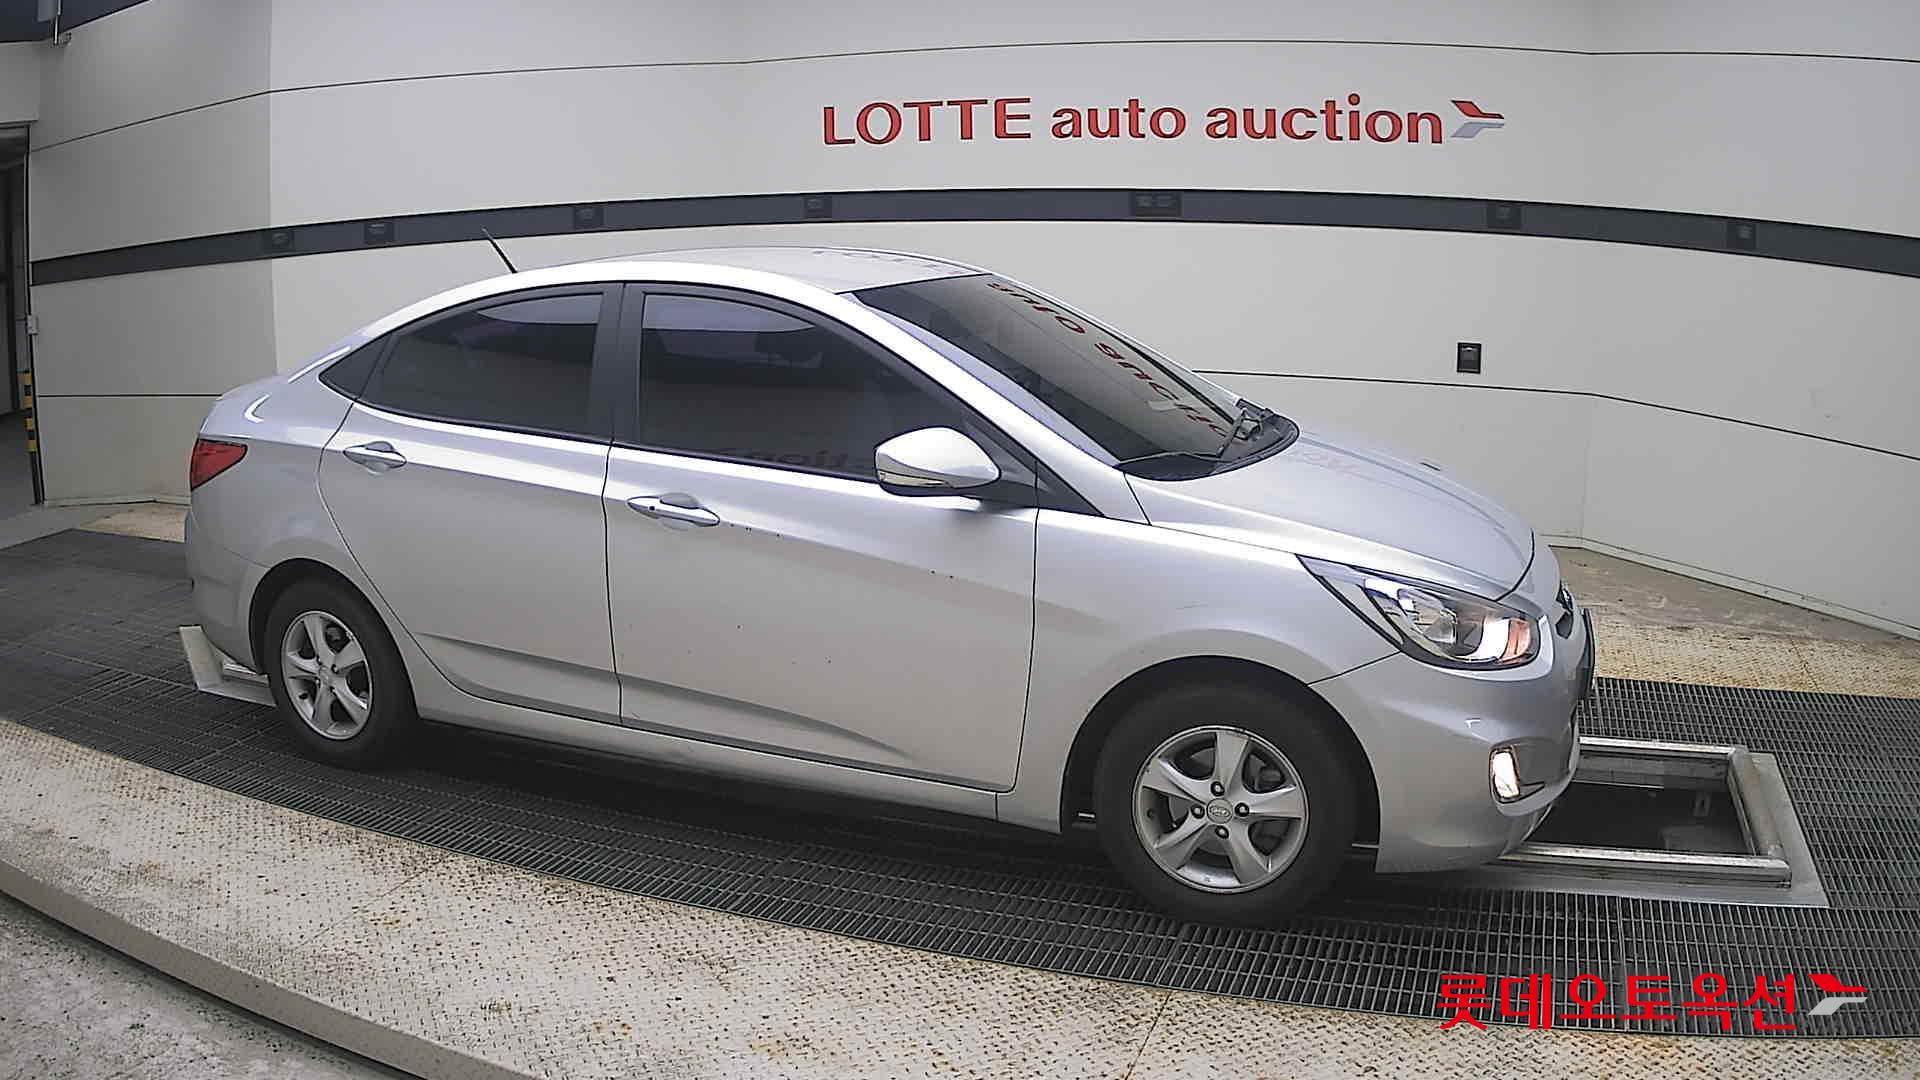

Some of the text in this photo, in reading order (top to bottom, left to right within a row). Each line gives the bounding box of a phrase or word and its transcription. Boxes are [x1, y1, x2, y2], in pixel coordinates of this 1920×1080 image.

[823, 94, 1443, 145] LOTTE auto auction
